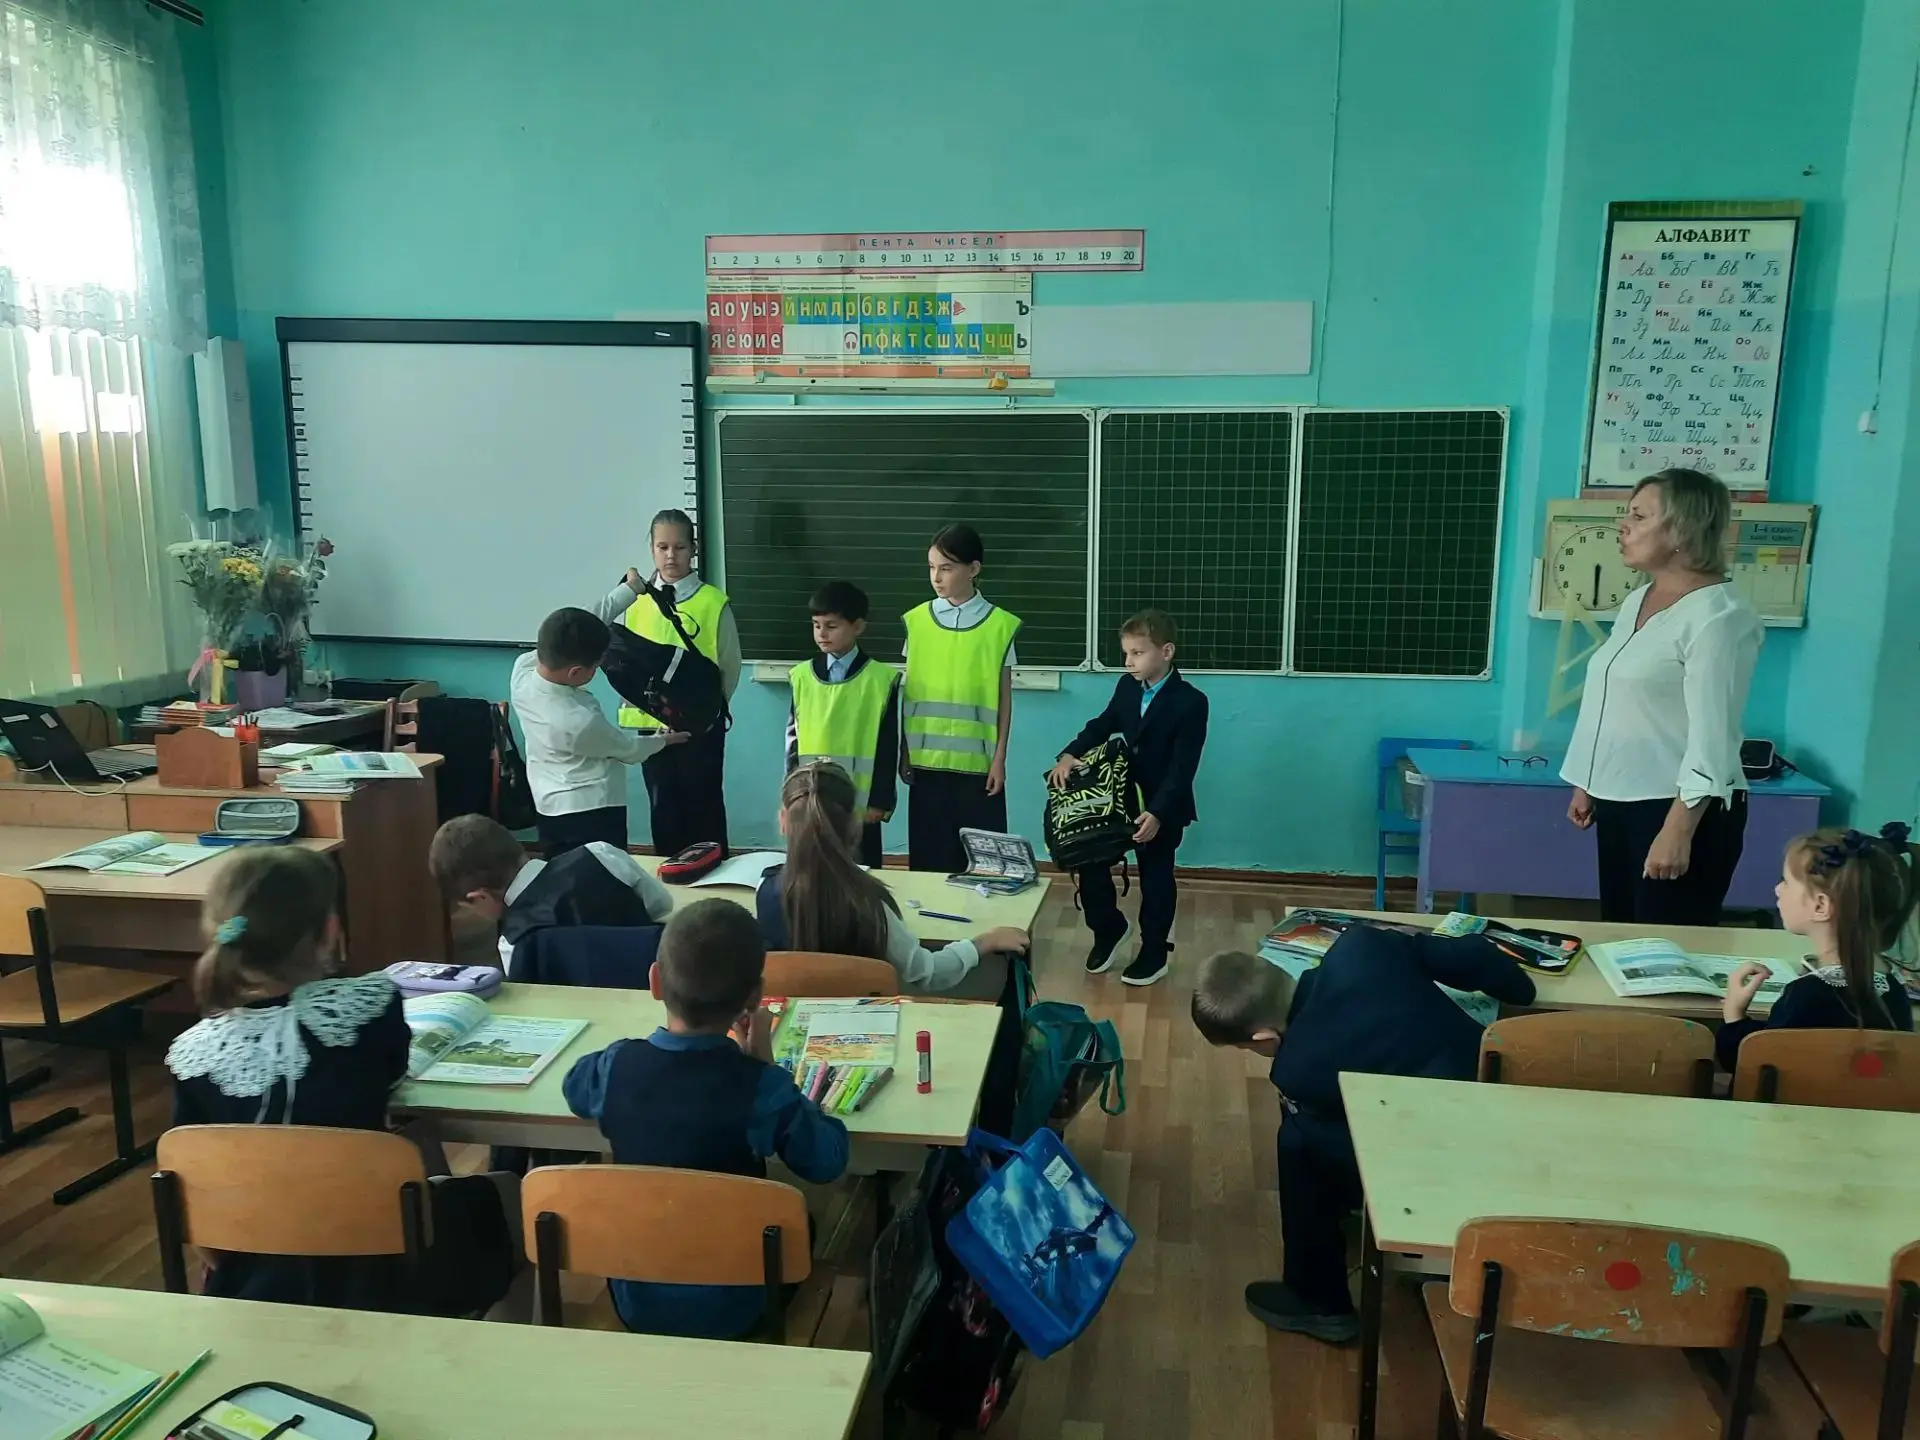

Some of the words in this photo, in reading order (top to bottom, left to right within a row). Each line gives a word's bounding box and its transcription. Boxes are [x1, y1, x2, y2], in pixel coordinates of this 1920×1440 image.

[1655, 229, 1750, 243] АЛФАВИТ
[934, 237, 993, 246] ЧИСЕЛ
[901, 254, 911, 263] 10
[923, 253, 932, 263] 11
[945, 253, 955, 262] 12
[967, 253, 977, 262] 13
[988, 253, 999, 262] 14
[1010, 252, 1021, 261] 15
[1033, 252, 1044, 261] 16
[1055, 252, 1066, 260] 17
[1078, 251, 1089, 260] 18
[1100, 251, 1111, 260] 19
[1123, 250, 1135, 260] 20
[1620, 252, 1634, 261] Аа
[1661, 252, 1674, 260] Бб
[1704, 252, 1716, 260] Вв
[1745, 252, 1755, 260] Гг
[1617, 282, 1633, 290] Дд
[1659, 281, 1670, 289] Ее
[1701, 280, 1713, 288] Ёё
[1742, 281, 1762, 289] Жж
[1698, 309, 1712, 317] Йй
[1736, 337, 1751, 345] Оо
[1650, 366, 1663, 375] Рр
[1607, 392, 1619, 402] Уу
[1647, 393, 1664, 402] Фф
[1730, 394, 1745, 403] Цц
[1685, 420, 1706, 429] Щщ
[1596, 531, 1605, 539] 12
[1565, 547, 1574, 556] 10
